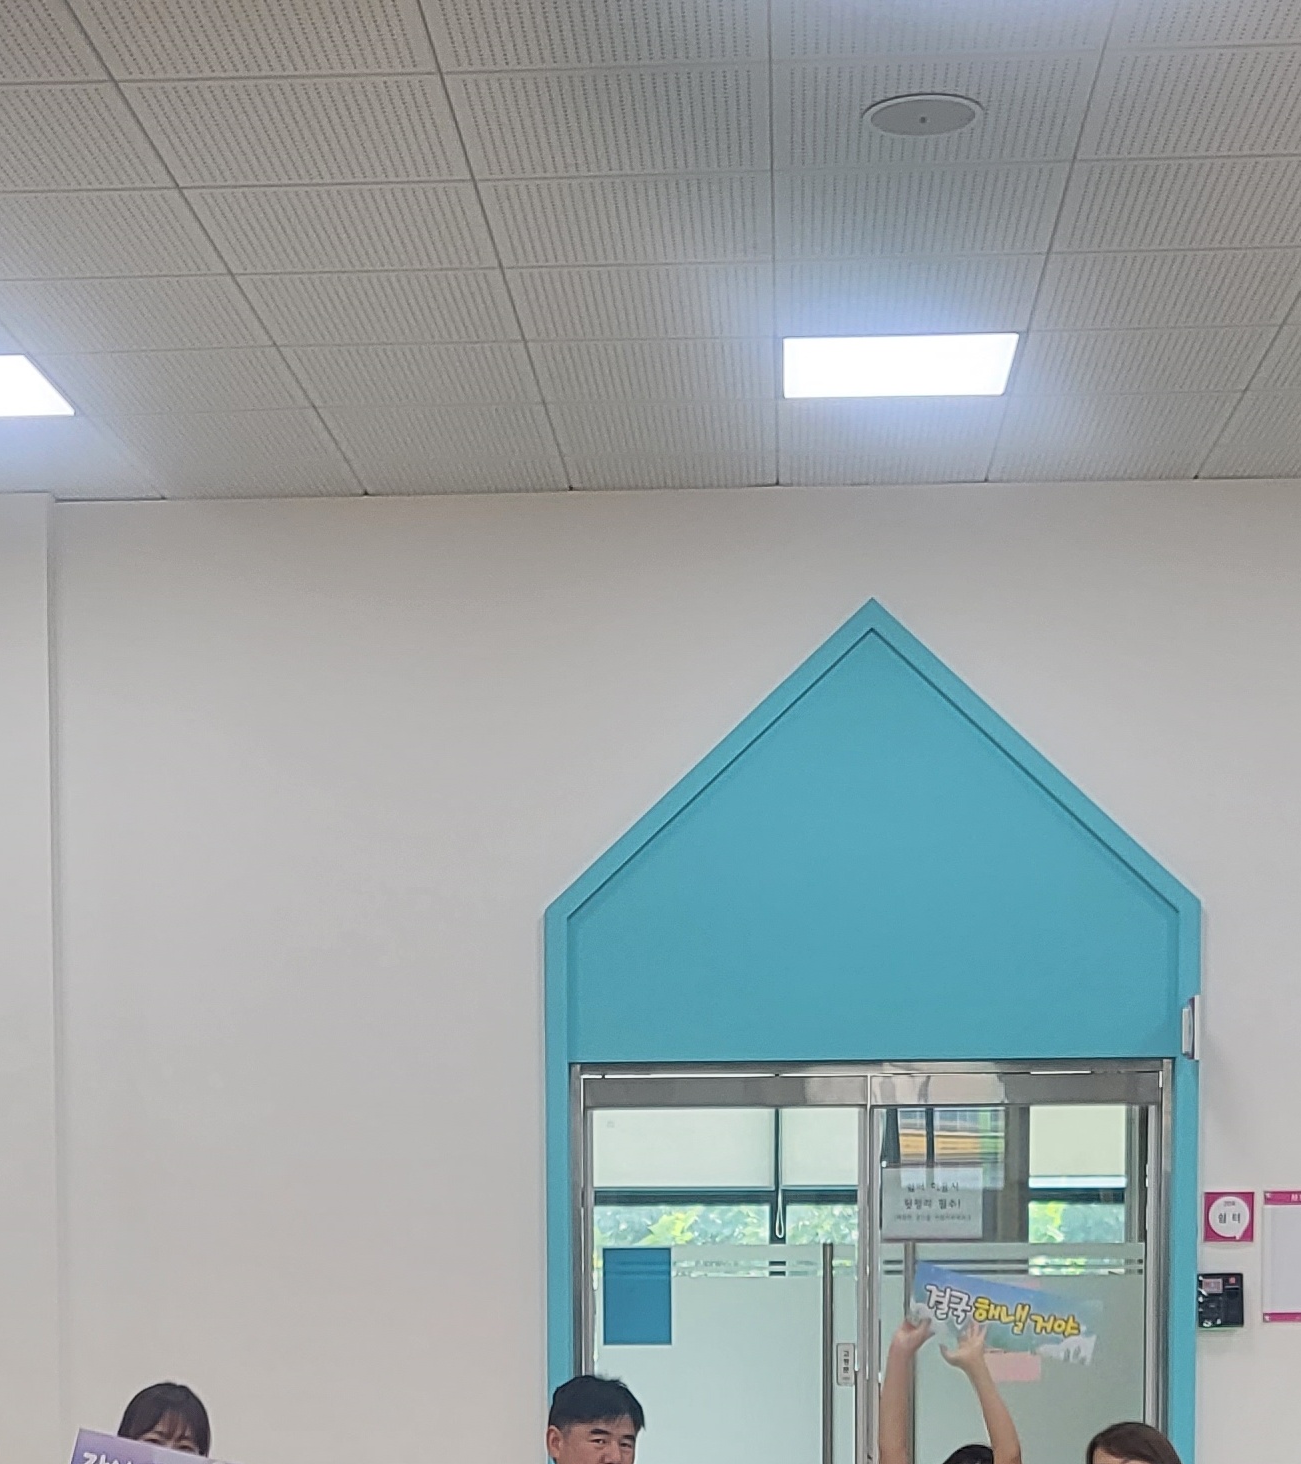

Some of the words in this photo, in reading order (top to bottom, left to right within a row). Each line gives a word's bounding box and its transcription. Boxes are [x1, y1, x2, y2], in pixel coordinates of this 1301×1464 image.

[925, 1284, 973, 1325] 결국
[972, 1296, 1031, 1335] 해낼
[1030, 1313, 1081, 1339] 거야
